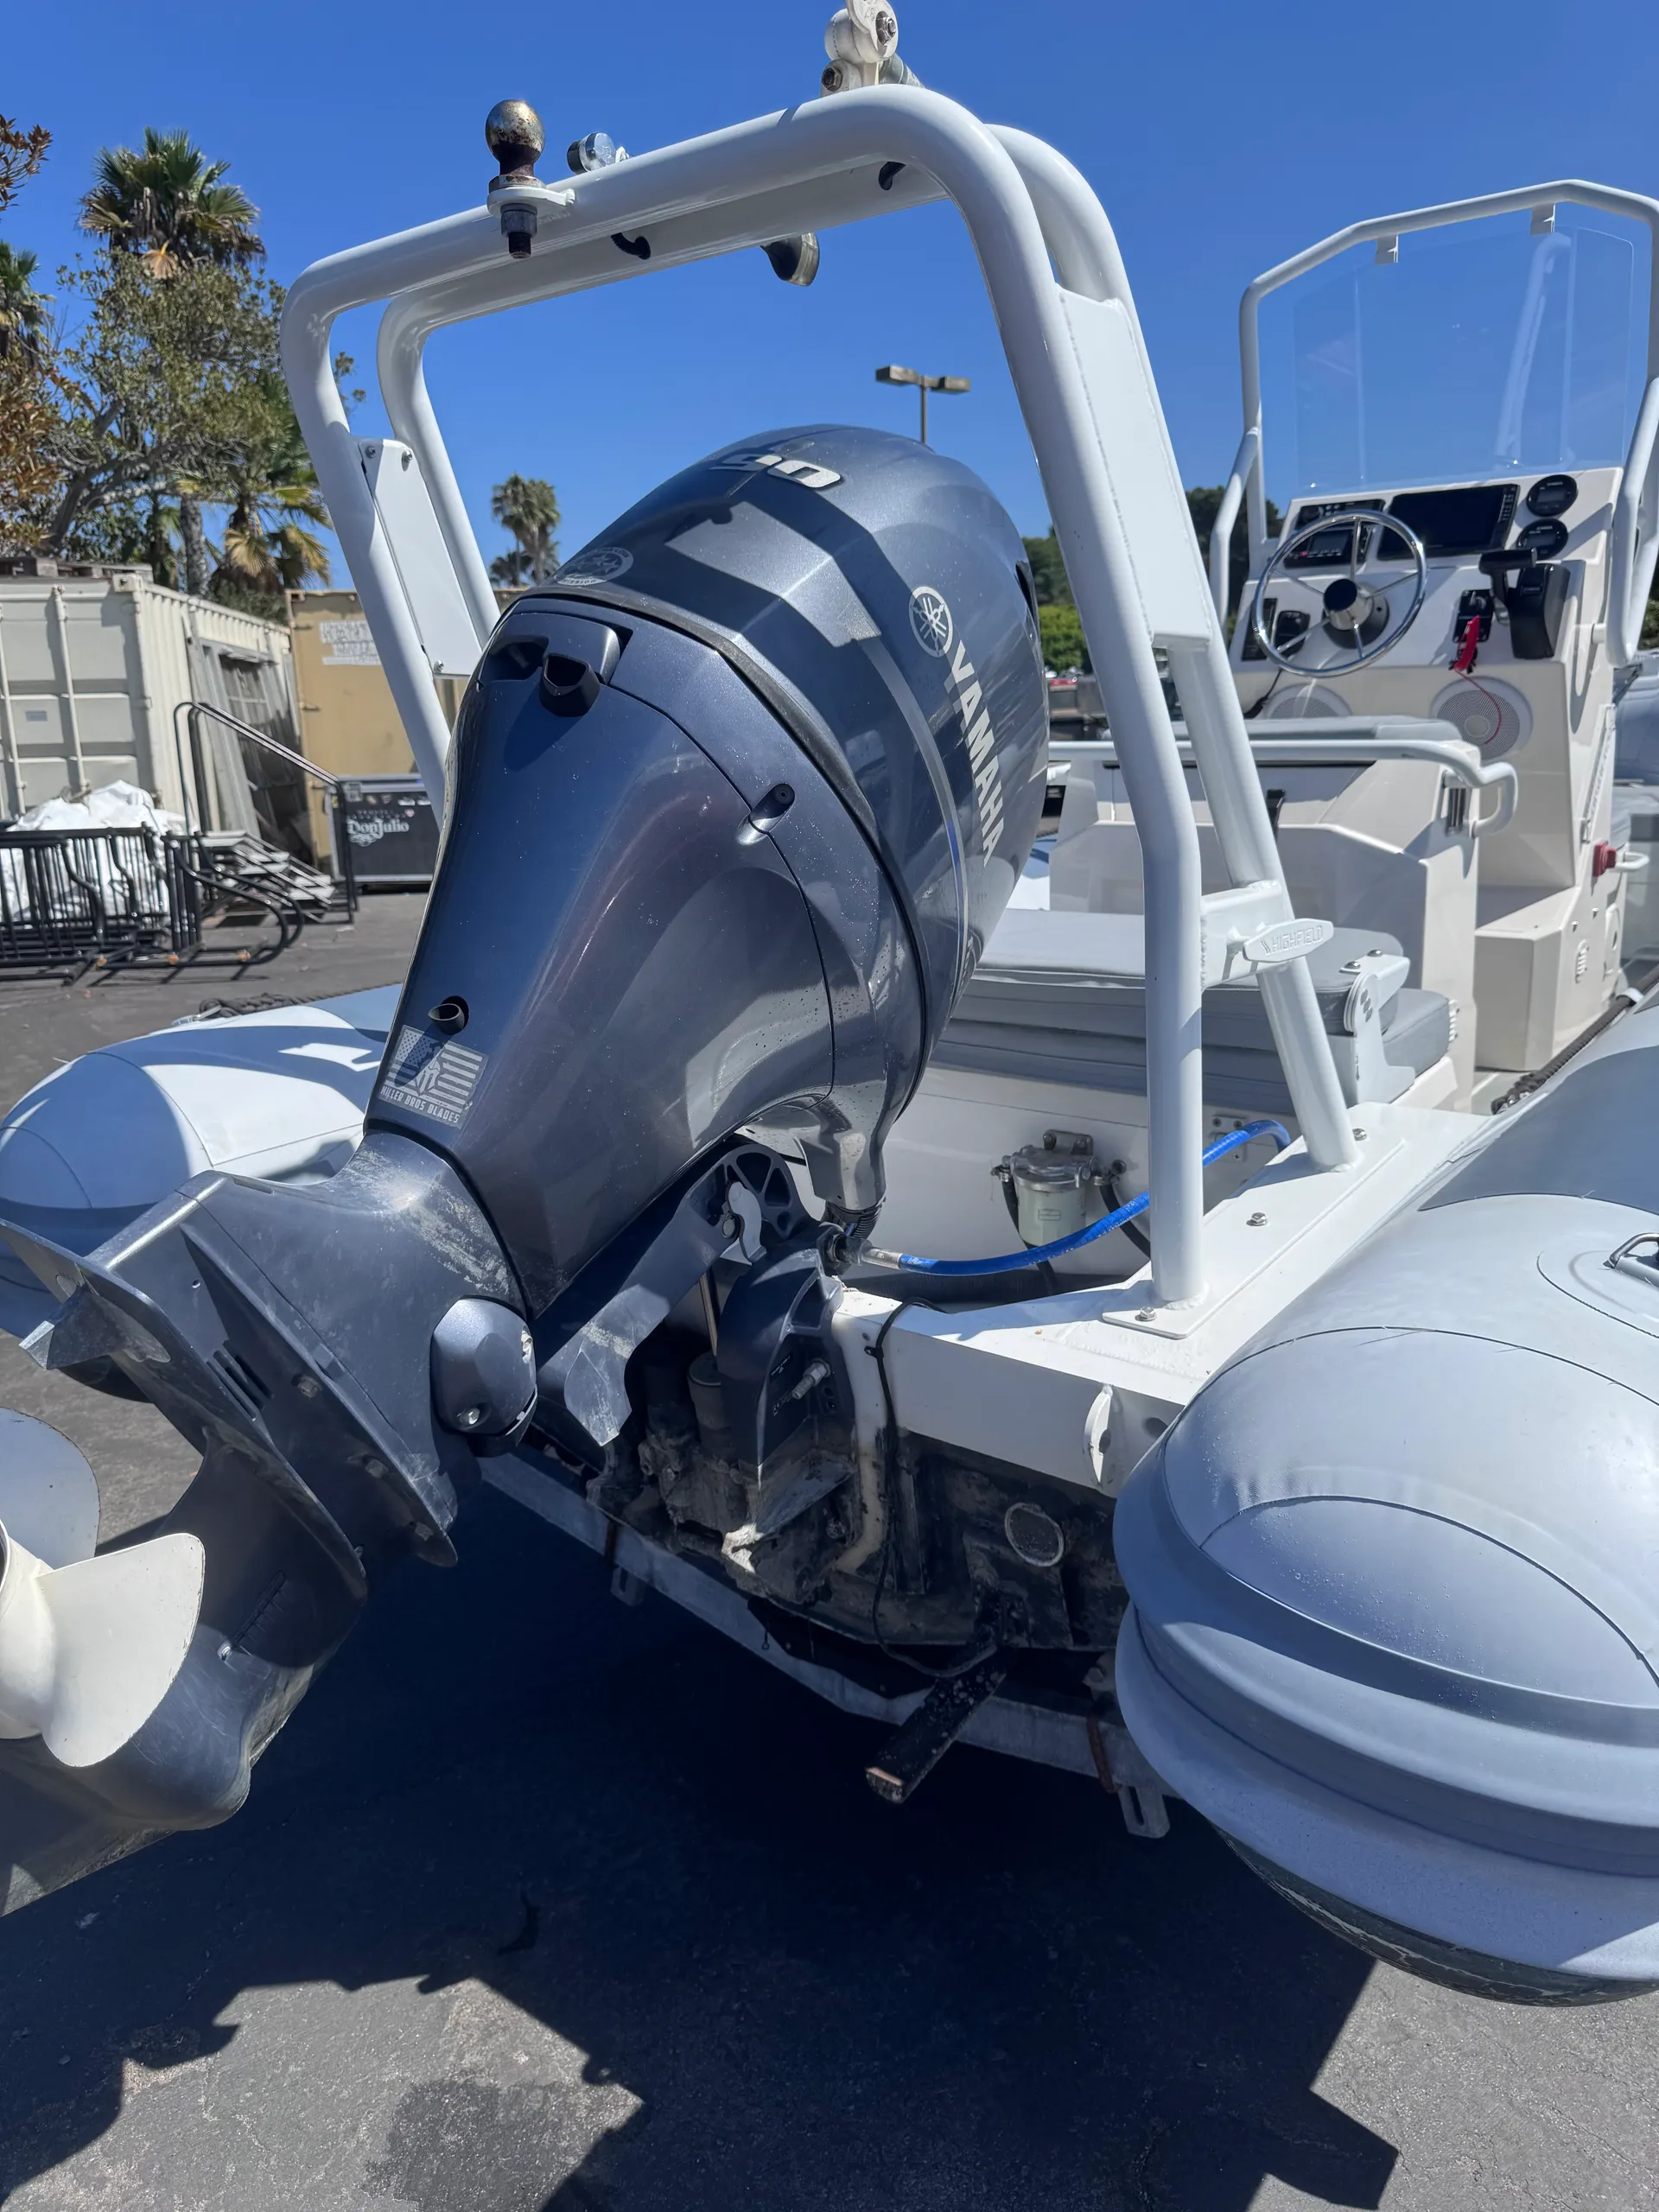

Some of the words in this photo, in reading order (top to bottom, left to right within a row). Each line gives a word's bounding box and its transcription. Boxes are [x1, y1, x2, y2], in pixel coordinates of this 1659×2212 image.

[944, 639, 1004, 868] YAMAHA
[1273, 925, 1323, 952] HIGHFIELD
[380, 1085, 404, 1102] MILLER
[404, 1096, 426, 1111] BROS
[427, 1103, 461, 1123] BLADES
